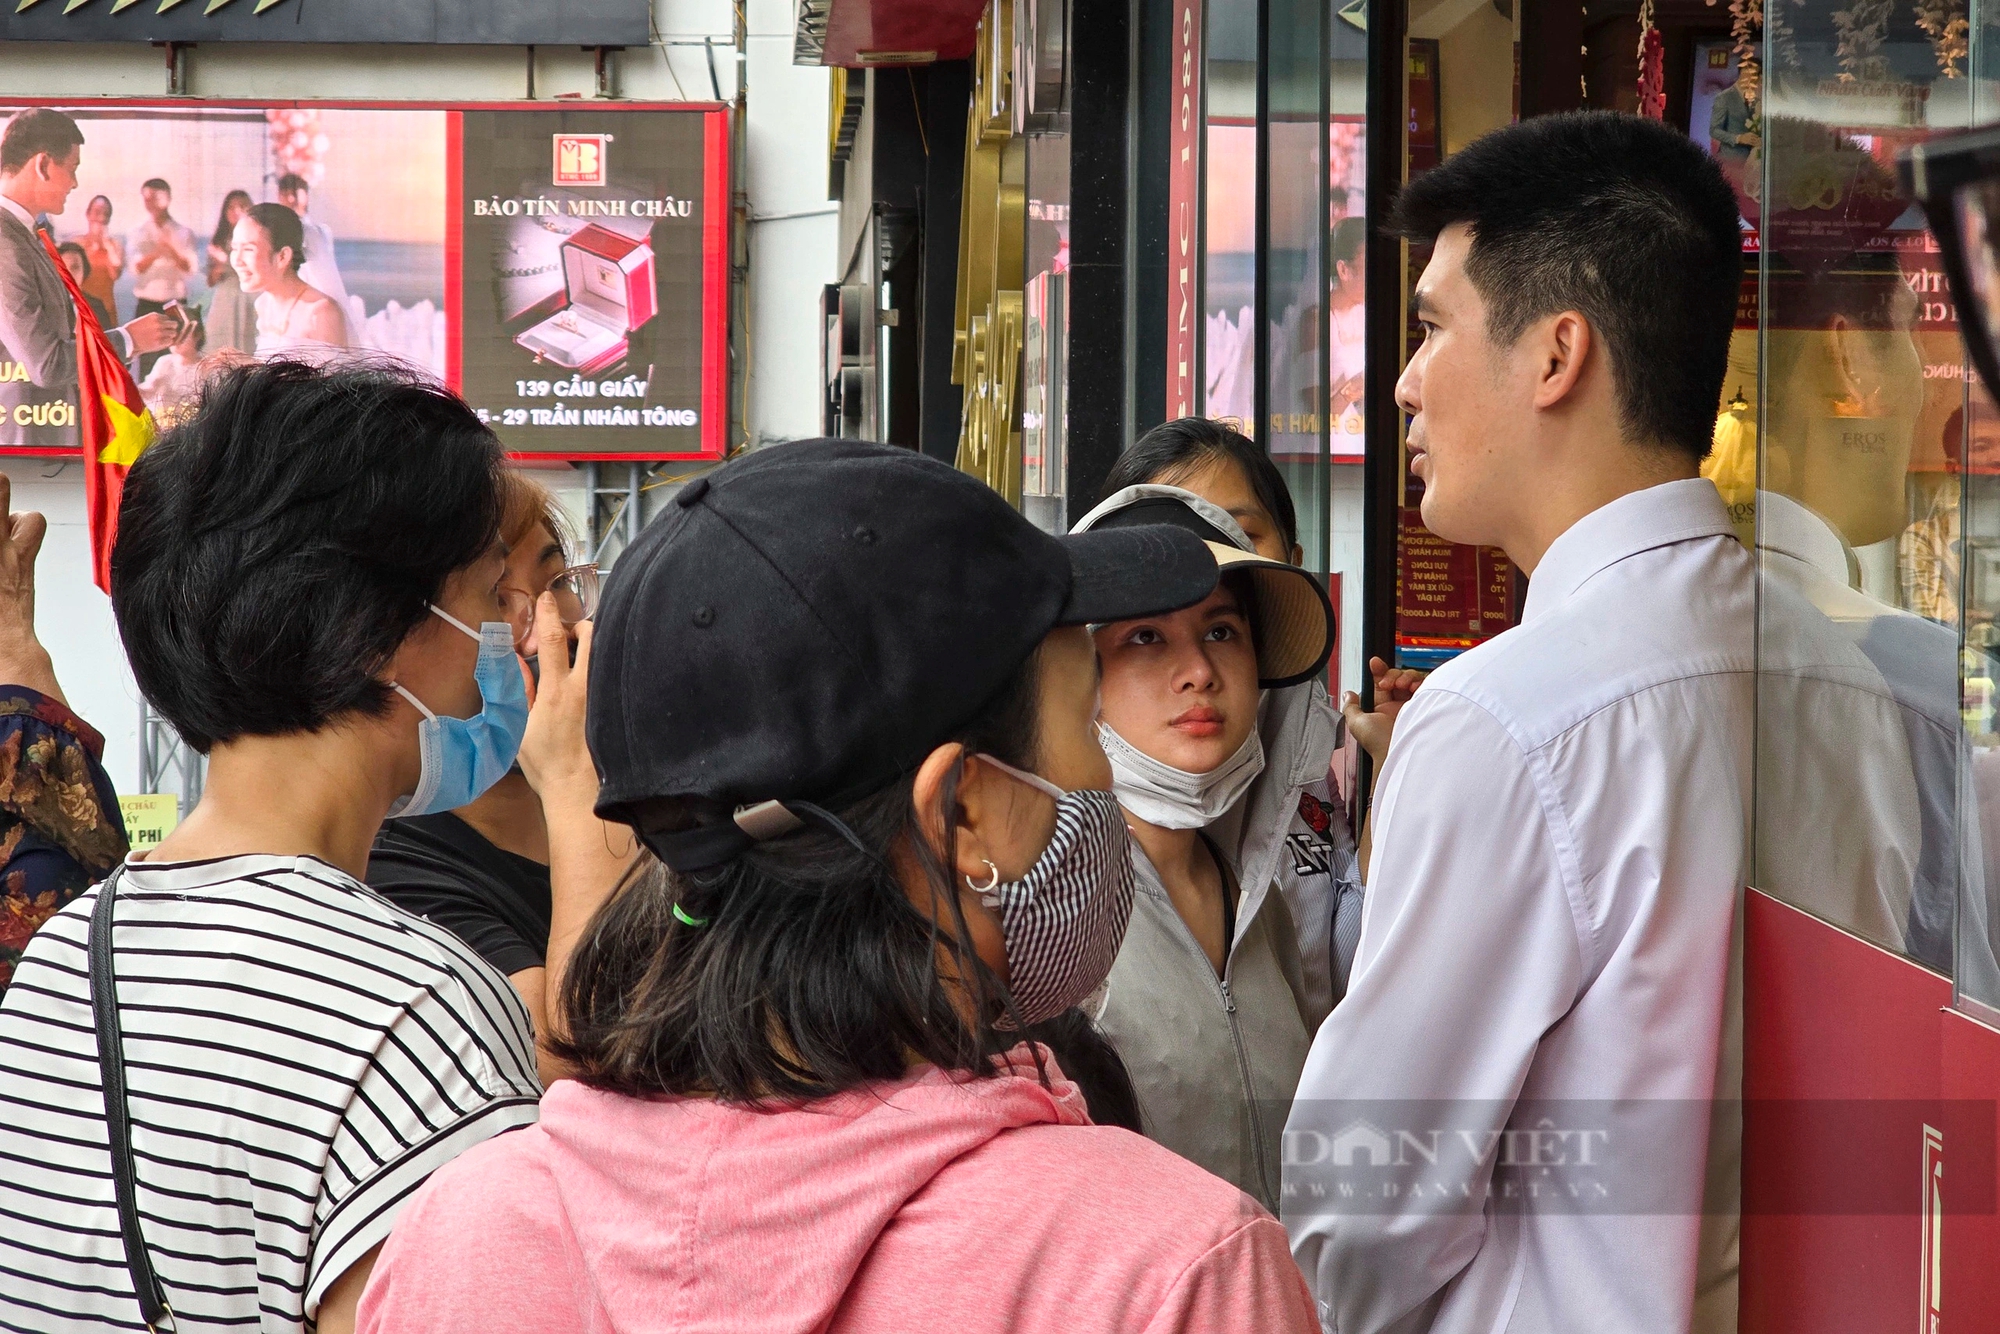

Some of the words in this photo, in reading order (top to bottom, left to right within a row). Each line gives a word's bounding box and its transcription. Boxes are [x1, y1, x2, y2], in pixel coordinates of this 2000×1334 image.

[1180, 6, 1191, 169] 1989
[473, 195, 519, 217] BẢO
[523, 195, 560, 216] TÍN
[567, 200, 626, 216] MINH
[630, 195, 693, 217] CHÂU
[515, 380, 550, 397] 139
[553, 374, 596, 397] CẦU
[600, 375, 648, 397] GIẤY
[13, 399, 75, 427] CƯỚI
[503, 409, 528, 426] 29
[530, 402, 579, 426] TRẦN
[583, 406, 639, 426] NHÂN
[642, 406, 698, 426] TÔNG
[127, 800, 157, 810] CHÂU
[138, 826, 162, 843] PHÍ
